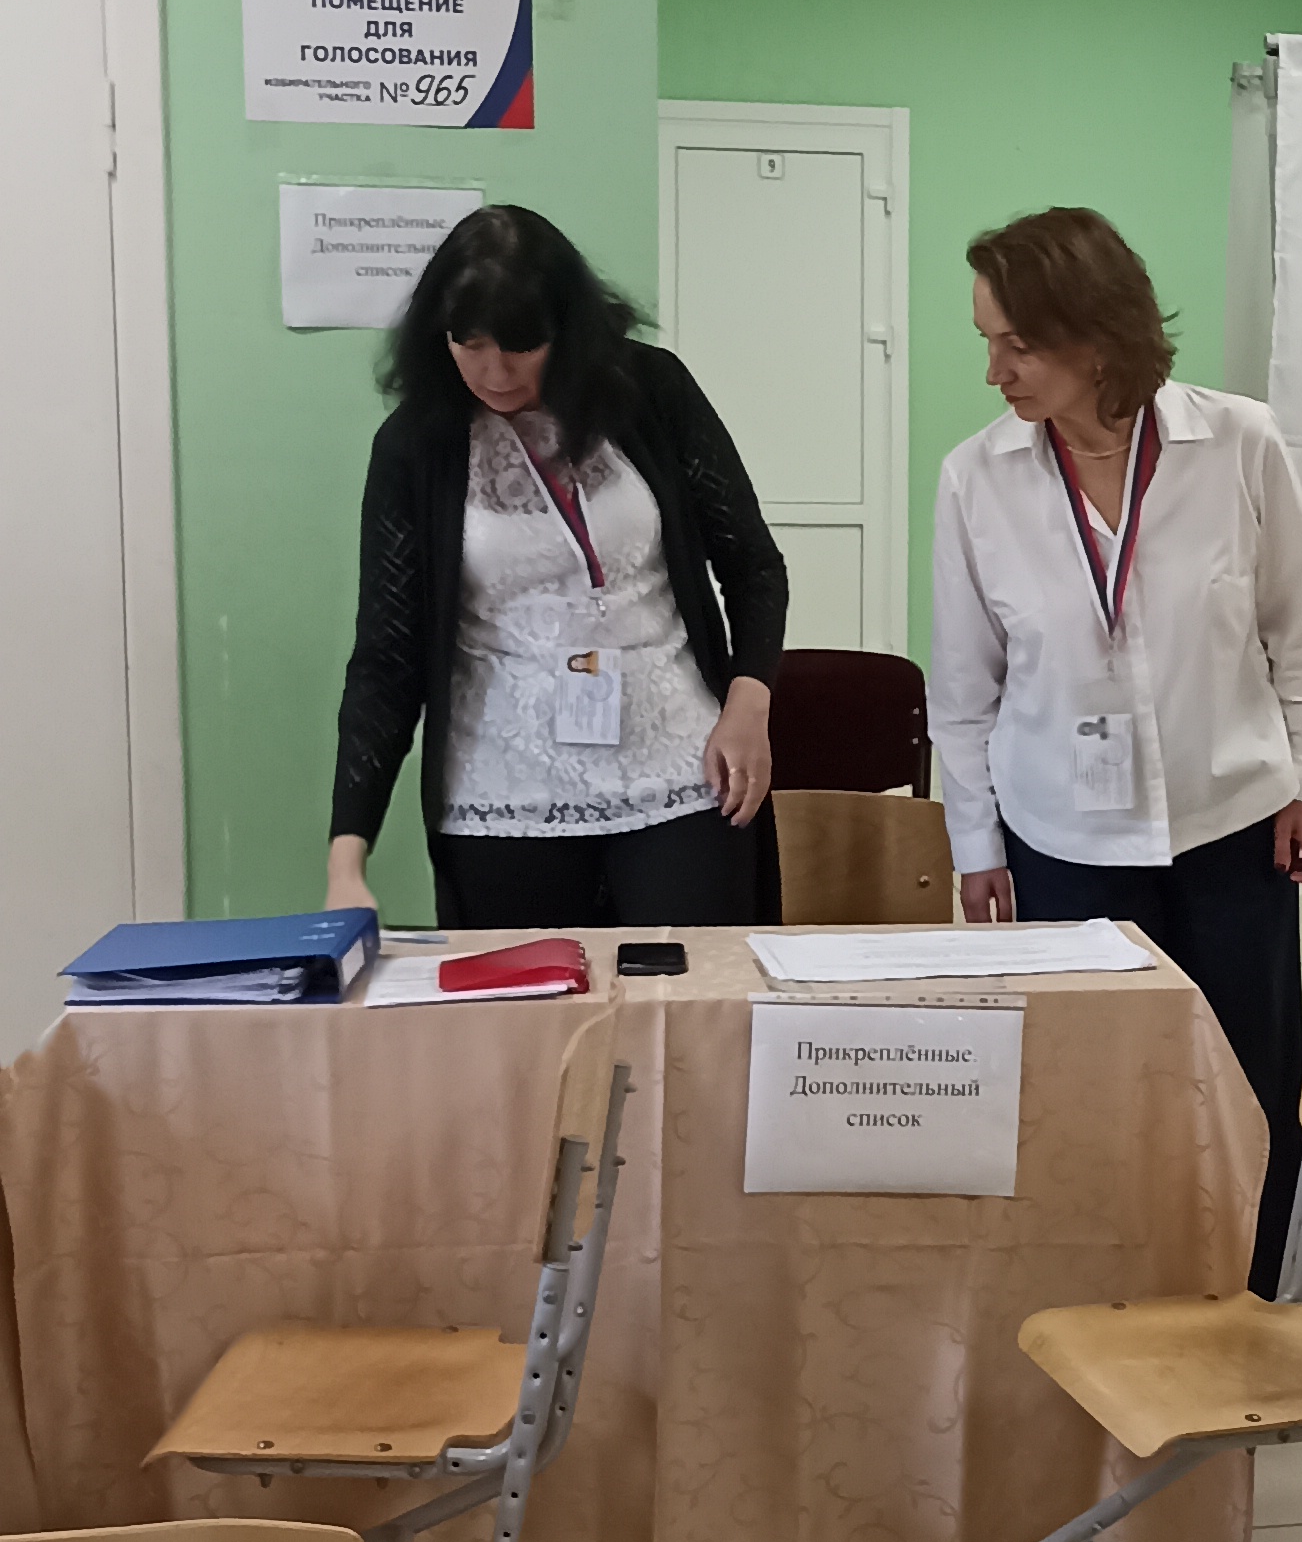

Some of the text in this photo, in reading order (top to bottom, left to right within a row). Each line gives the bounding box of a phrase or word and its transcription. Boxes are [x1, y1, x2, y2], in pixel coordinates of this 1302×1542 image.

[364, 20, 413, 39] ДЛЯ
[300, 45, 478, 67] ГОЛОСОВАНИЯ
[311, 237, 437, 255] Дополнительн
[354, 266, 413, 277] список
[790, 1076, 980, 1097] Дополнительный
[846, 1113, 922, 1127] список
